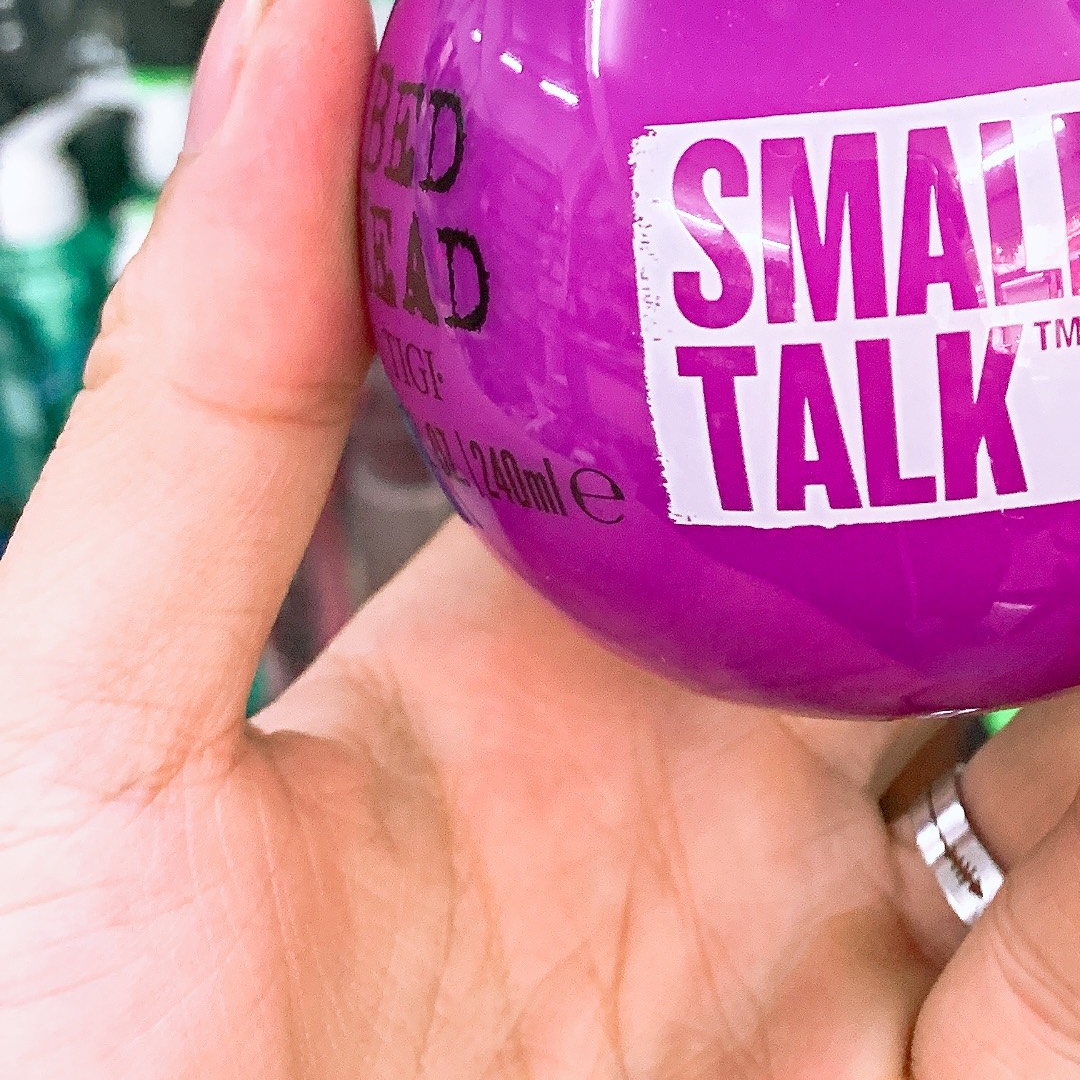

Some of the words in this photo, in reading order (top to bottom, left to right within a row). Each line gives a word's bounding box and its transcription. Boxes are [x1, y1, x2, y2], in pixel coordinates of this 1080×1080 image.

[362, 64, 467, 193] BED
[364, 204, 490, 333] EAD
[469, 440, 568, 516] 240ml
[676, 324, 1029, 512] TALK
